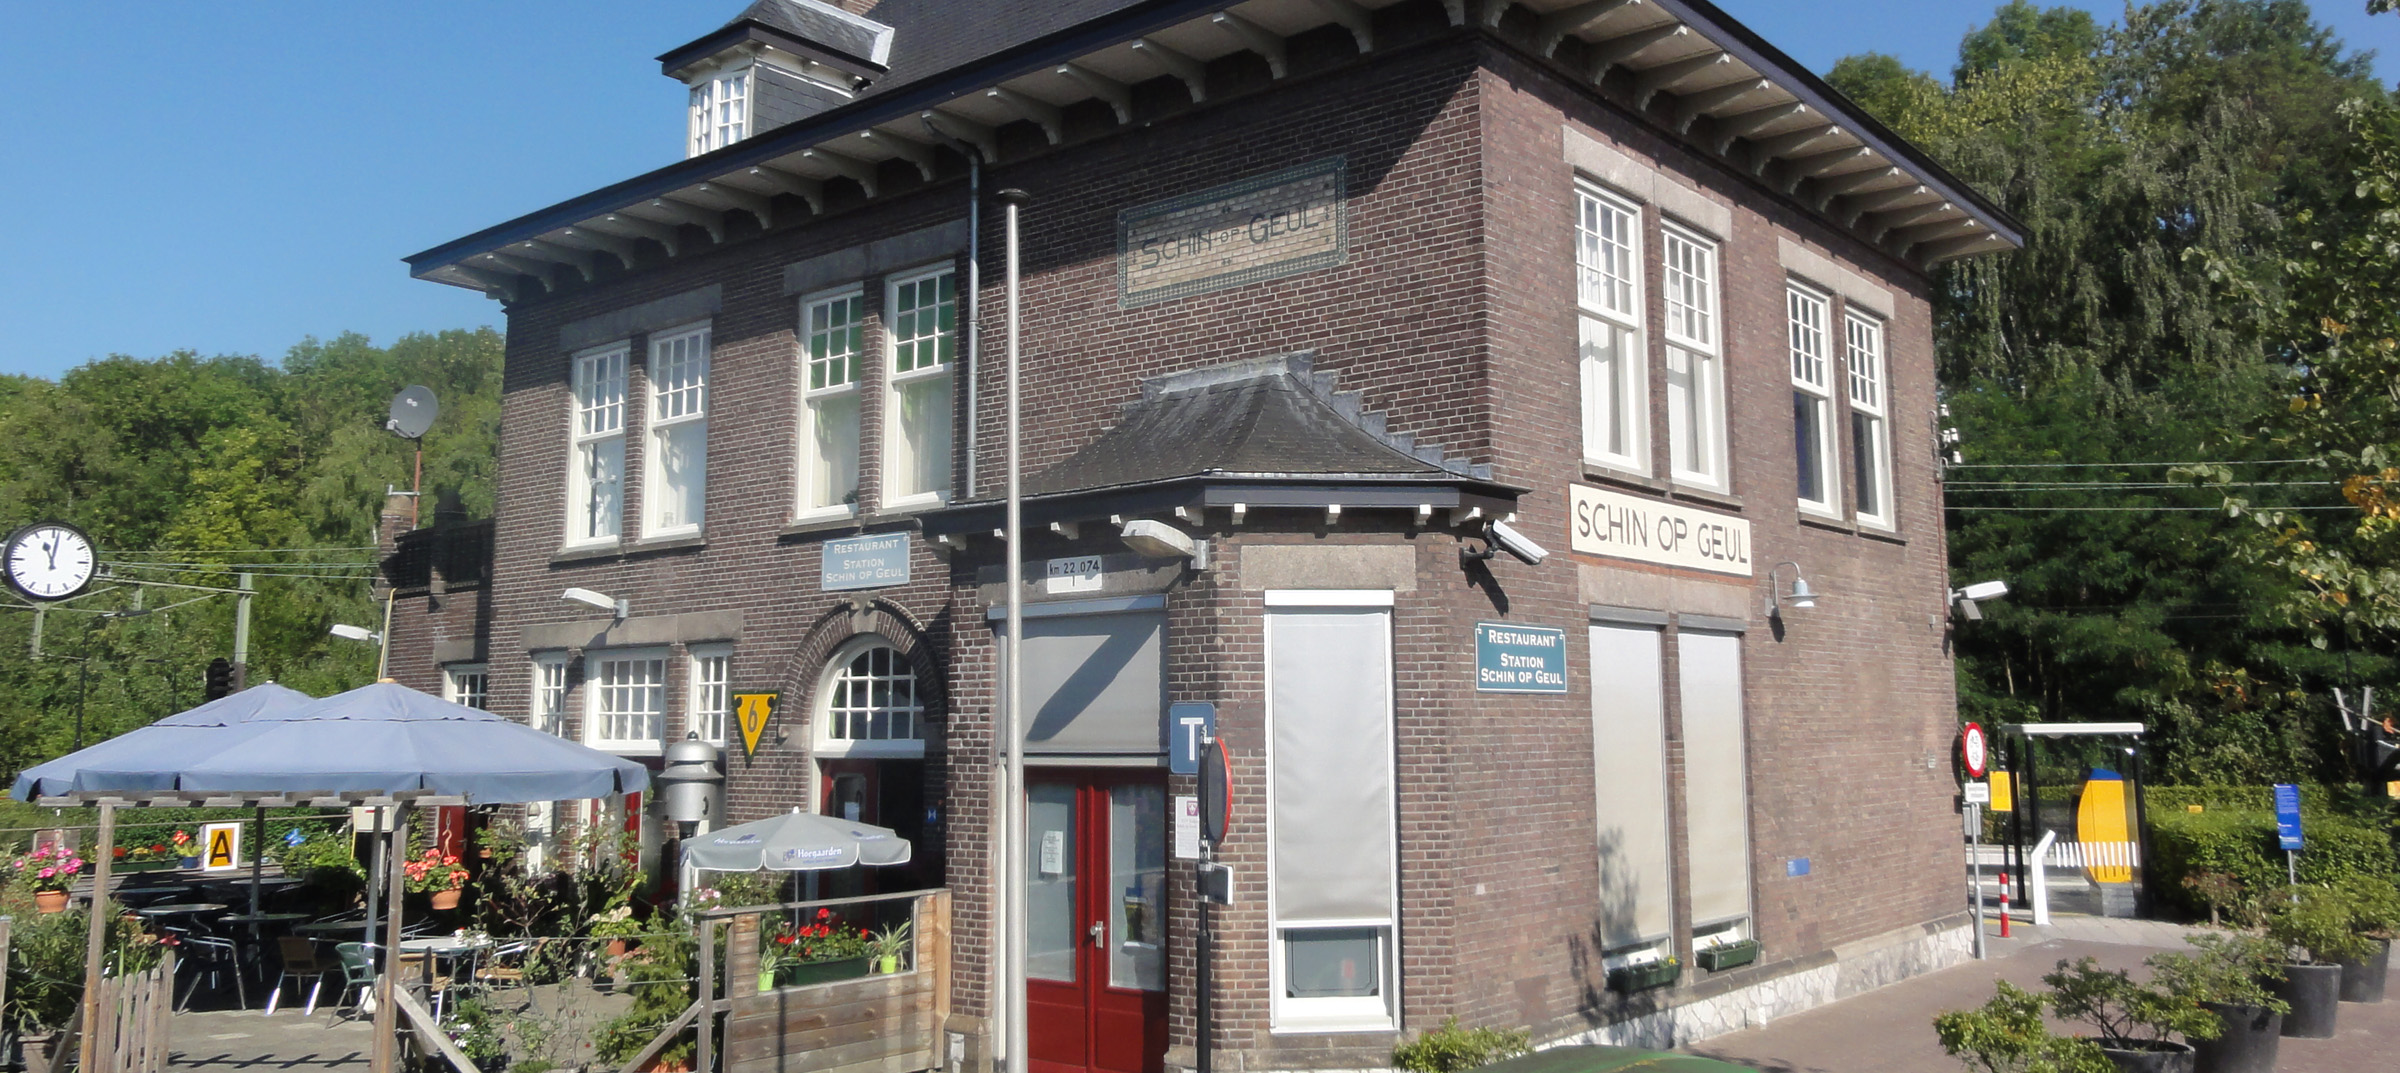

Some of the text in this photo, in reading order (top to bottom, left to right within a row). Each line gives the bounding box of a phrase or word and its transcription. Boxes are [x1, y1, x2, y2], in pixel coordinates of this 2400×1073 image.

[1141, 229, 1212, 270] SCHIN
[1249, 205, 1320, 245] GEUL
[1577, 499, 1748, 564] SCHIN OP GEUL
[833, 539, 899, 554] RESTAURANT
[843, 558, 885, 569] STATION
[1050, 563, 1060, 575] km
[826, 567, 905, 583] SCHIN OP GEUL
[1488, 629, 1556, 647] RESTAURANT
[1500, 652, 1544, 668] STATION
[1481, 667, 1564, 684] SCHIN OP GEUL
[747, 699, 759, 733] 6
[209, 830, 232, 865] A
